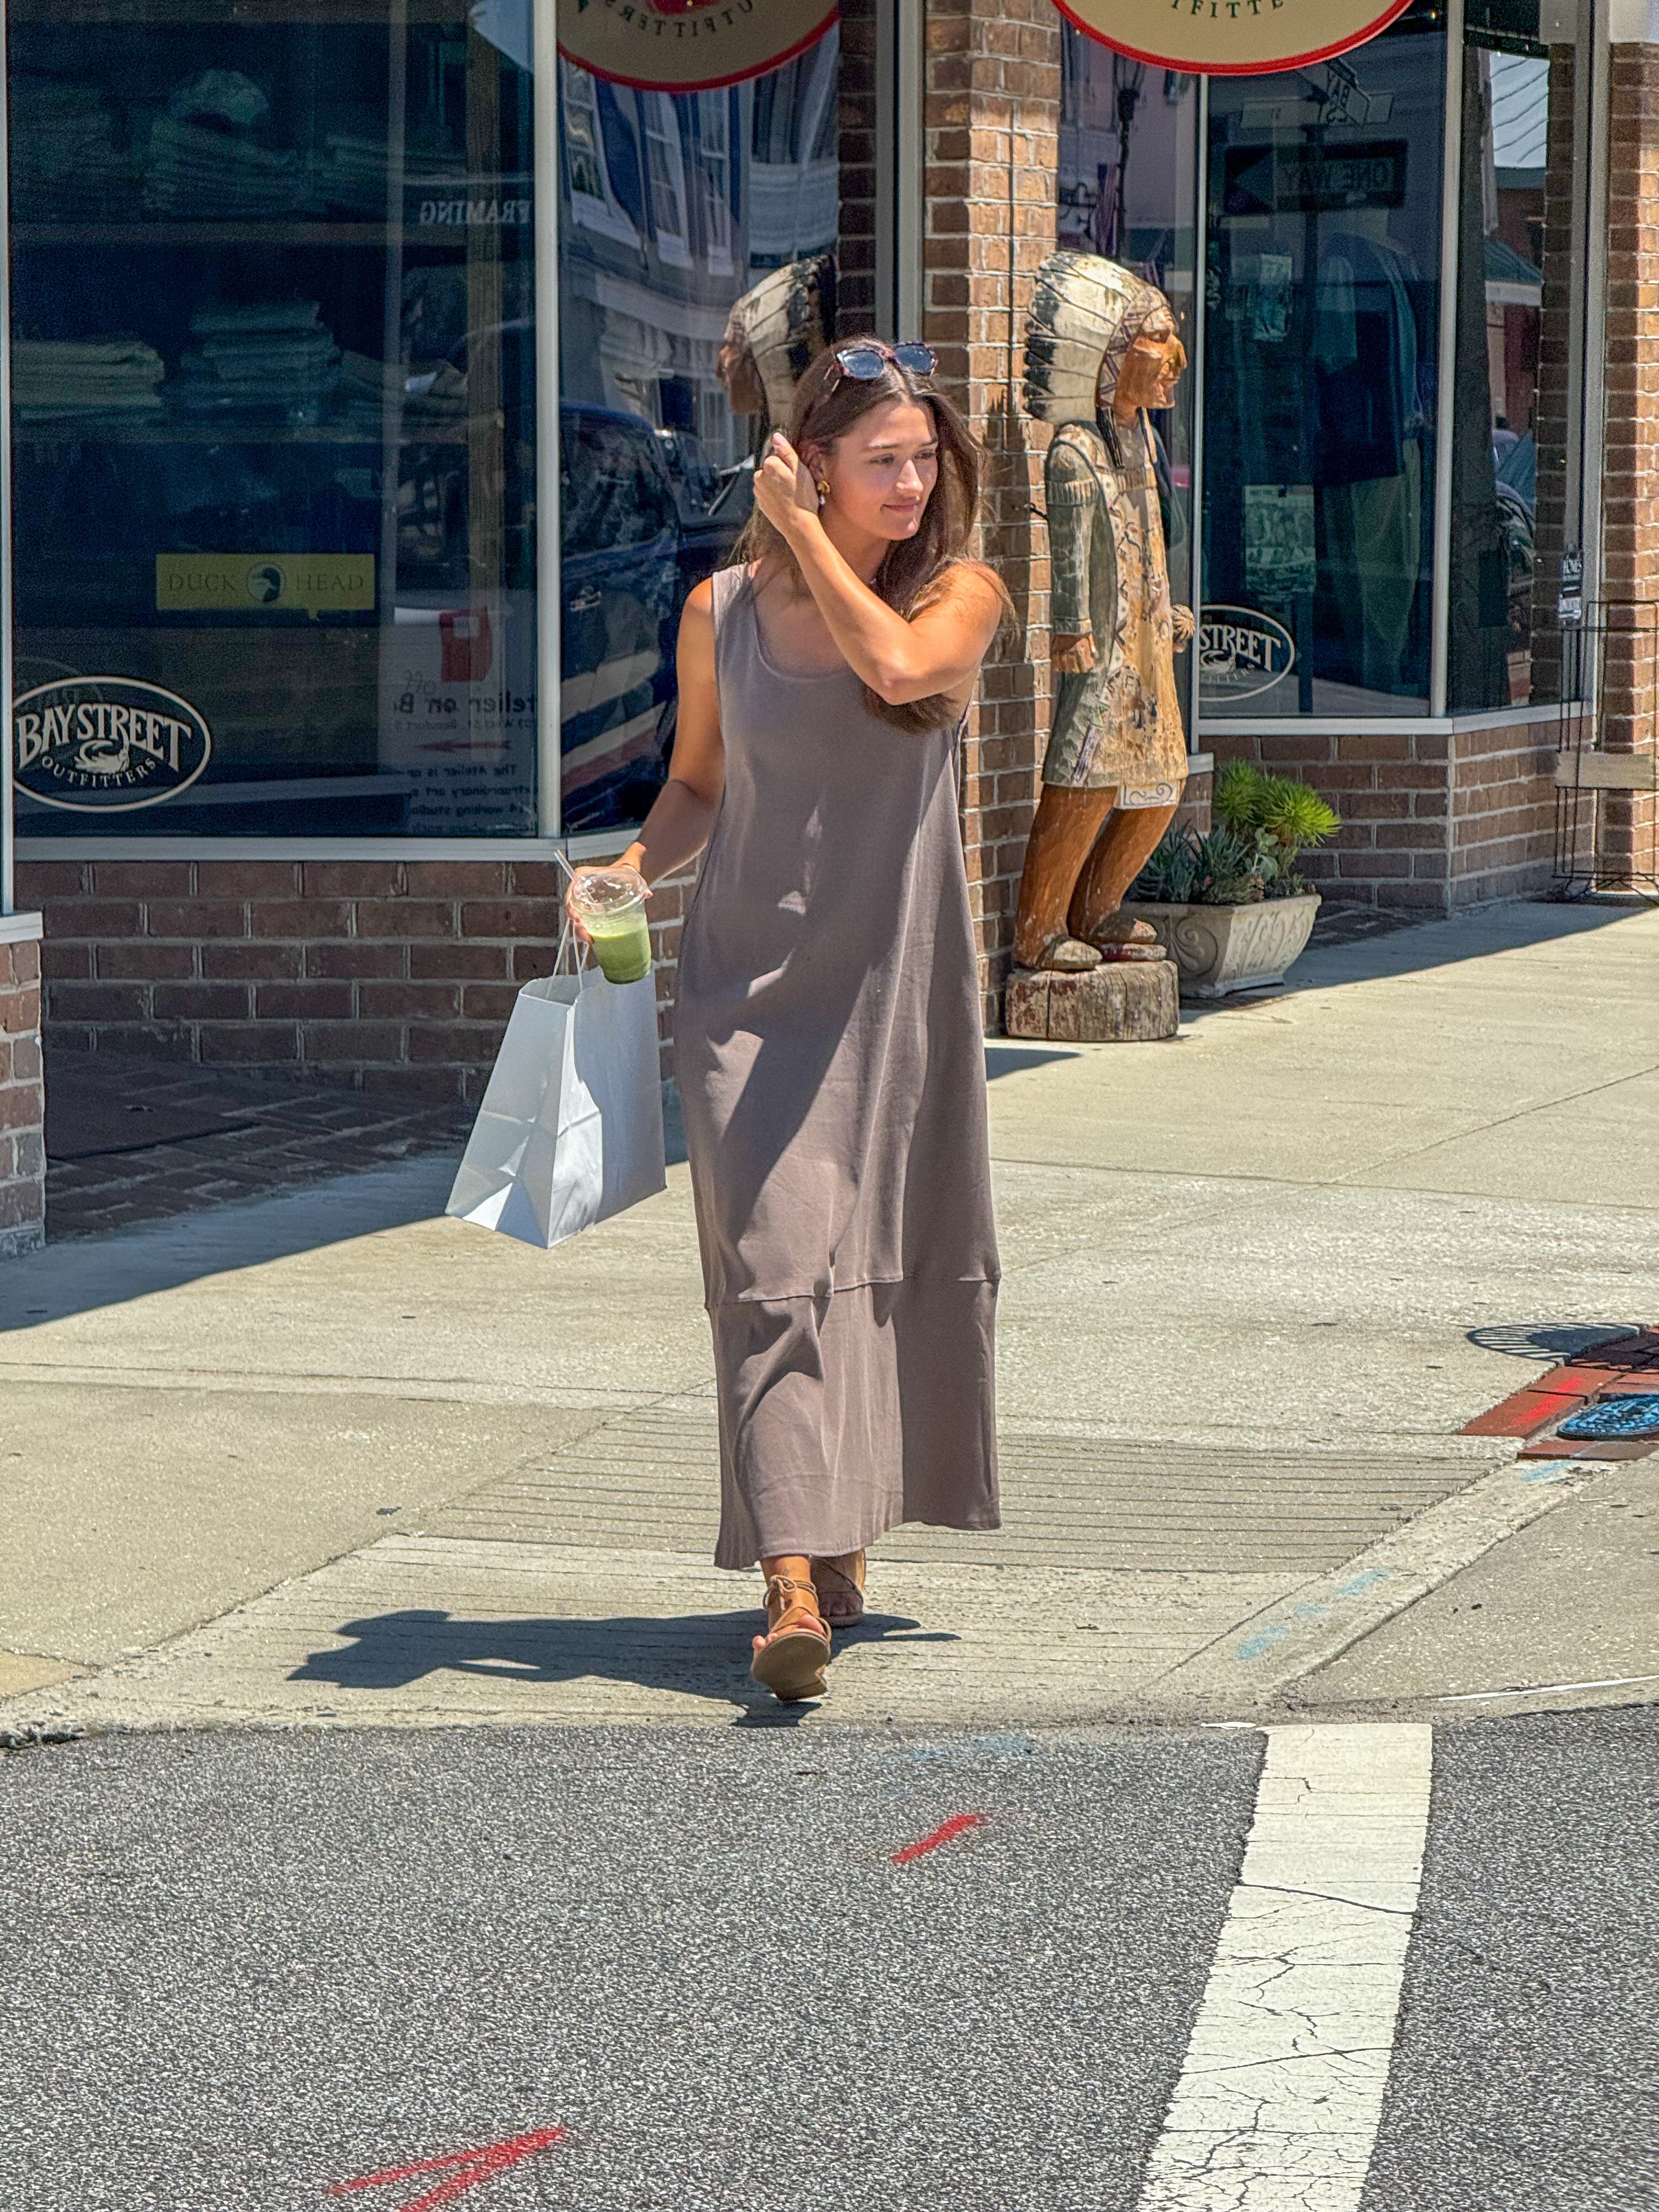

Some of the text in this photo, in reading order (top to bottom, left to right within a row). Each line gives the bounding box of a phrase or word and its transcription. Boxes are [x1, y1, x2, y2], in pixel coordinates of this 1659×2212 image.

[168, 573, 364, 592] DUCK HEAD
[1199, 624, 1282, 672] STREET
[41, 755, 156, 788] OUTFITTERS
